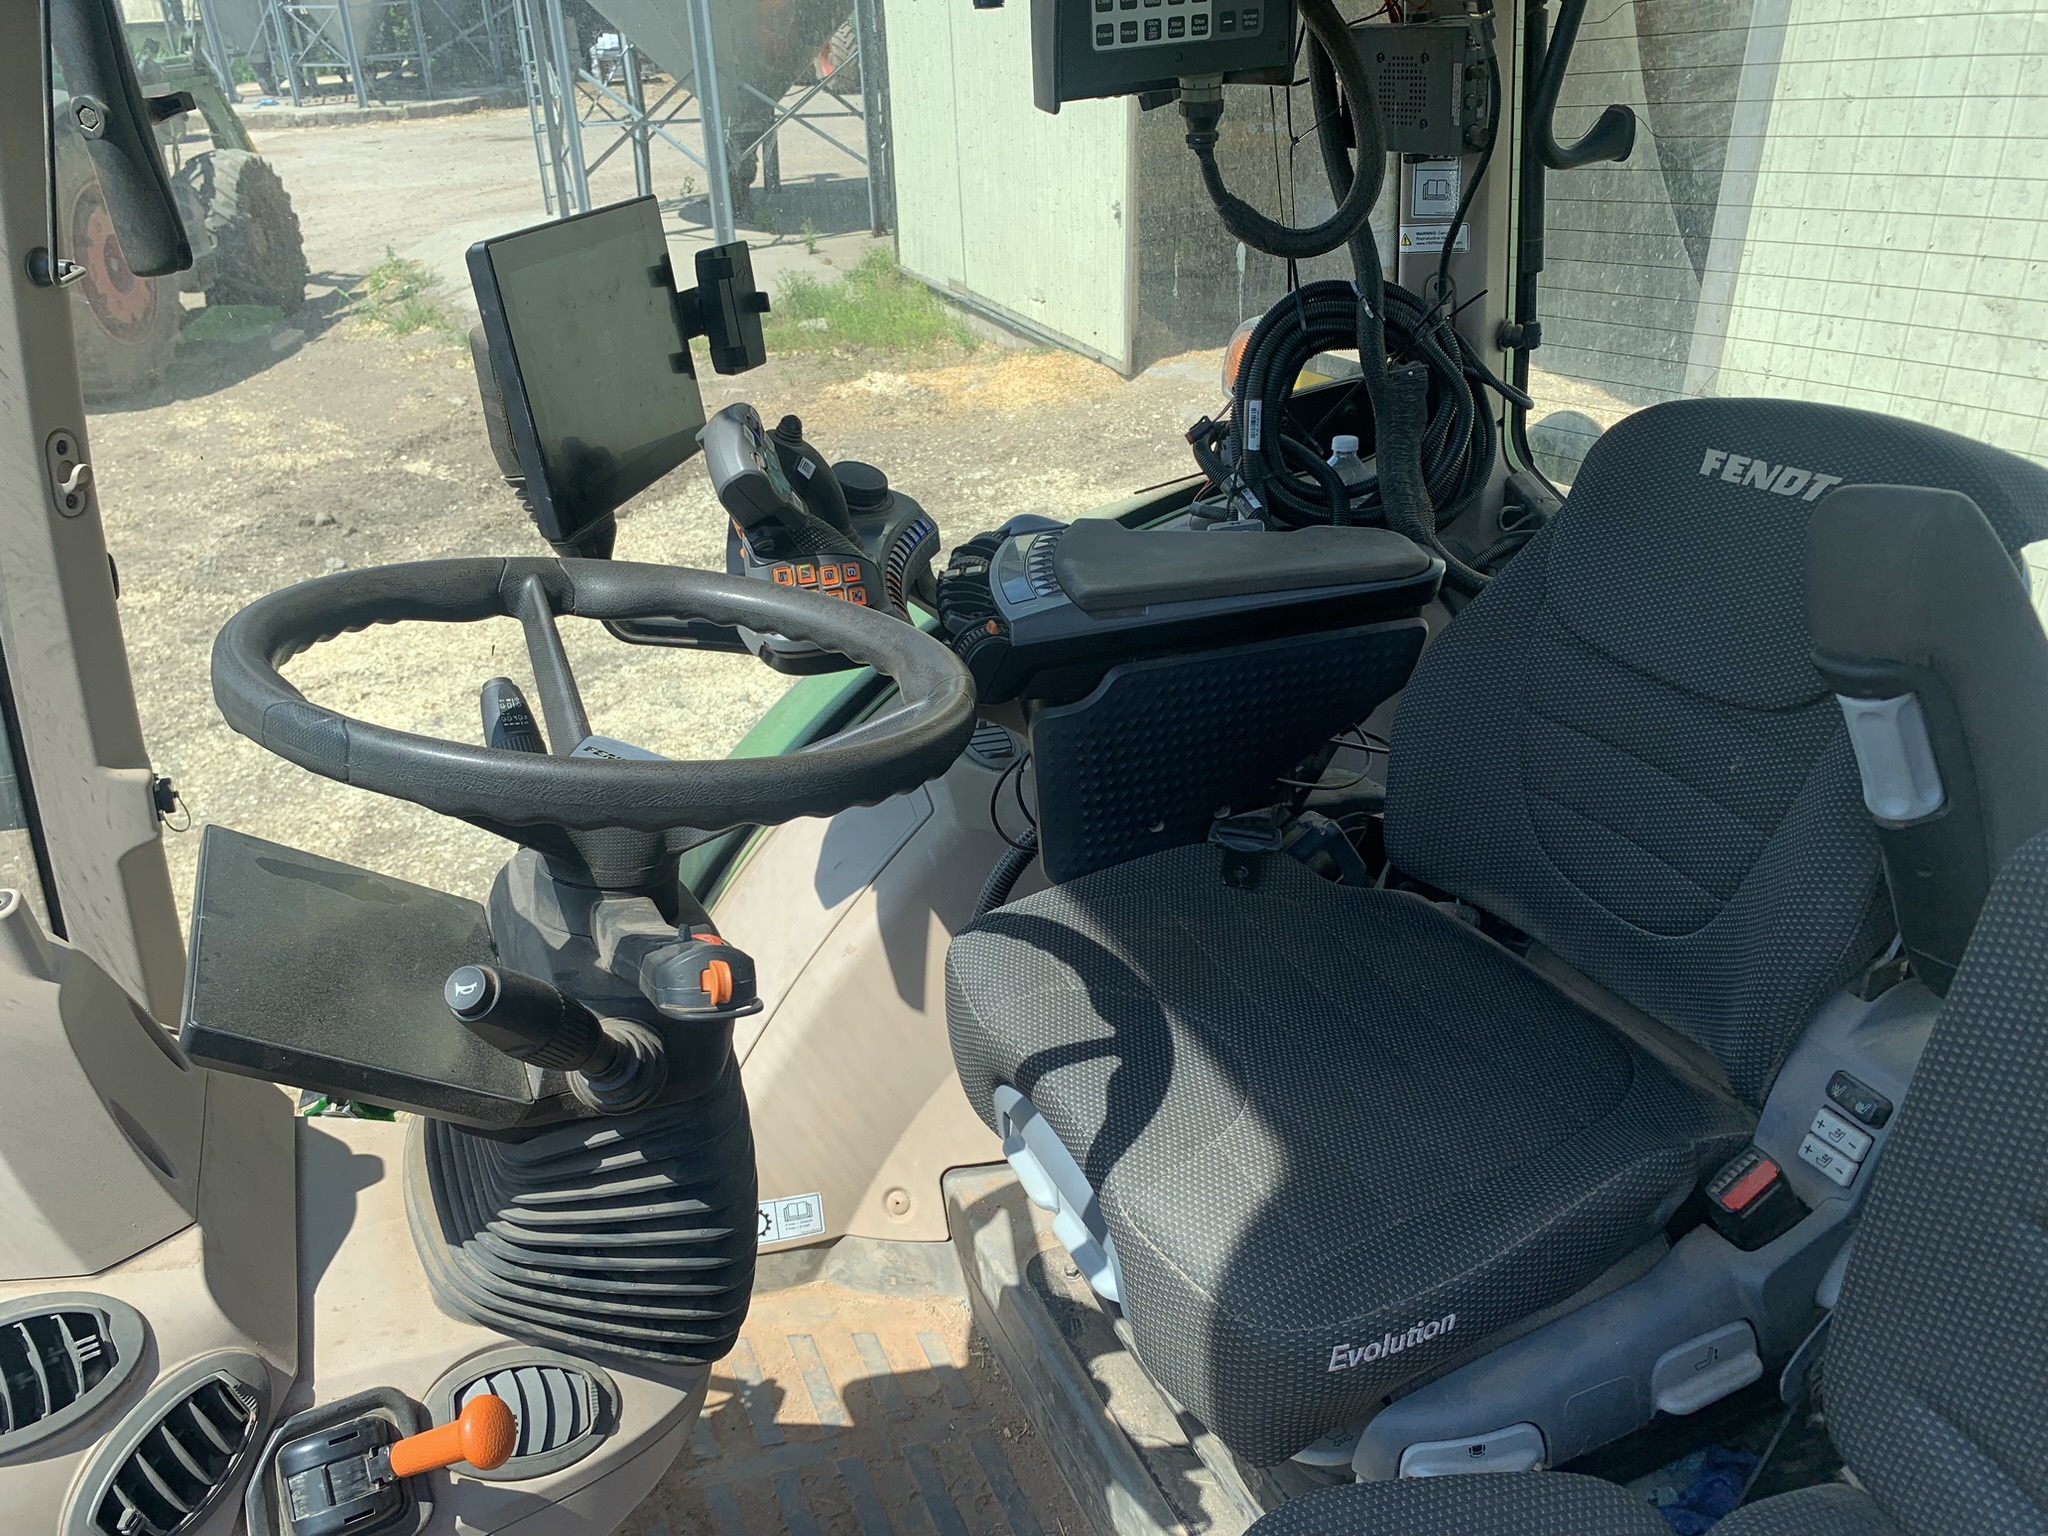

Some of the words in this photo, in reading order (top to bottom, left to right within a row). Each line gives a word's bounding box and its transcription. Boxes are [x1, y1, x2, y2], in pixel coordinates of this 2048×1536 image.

[1097, 31, 1113, 39] Extend
[1121, 29, 1137, 37] Retract
[1699, 447, 1843, 502] FENDT
[1328, 1313, 1457, 1372] Evolution
